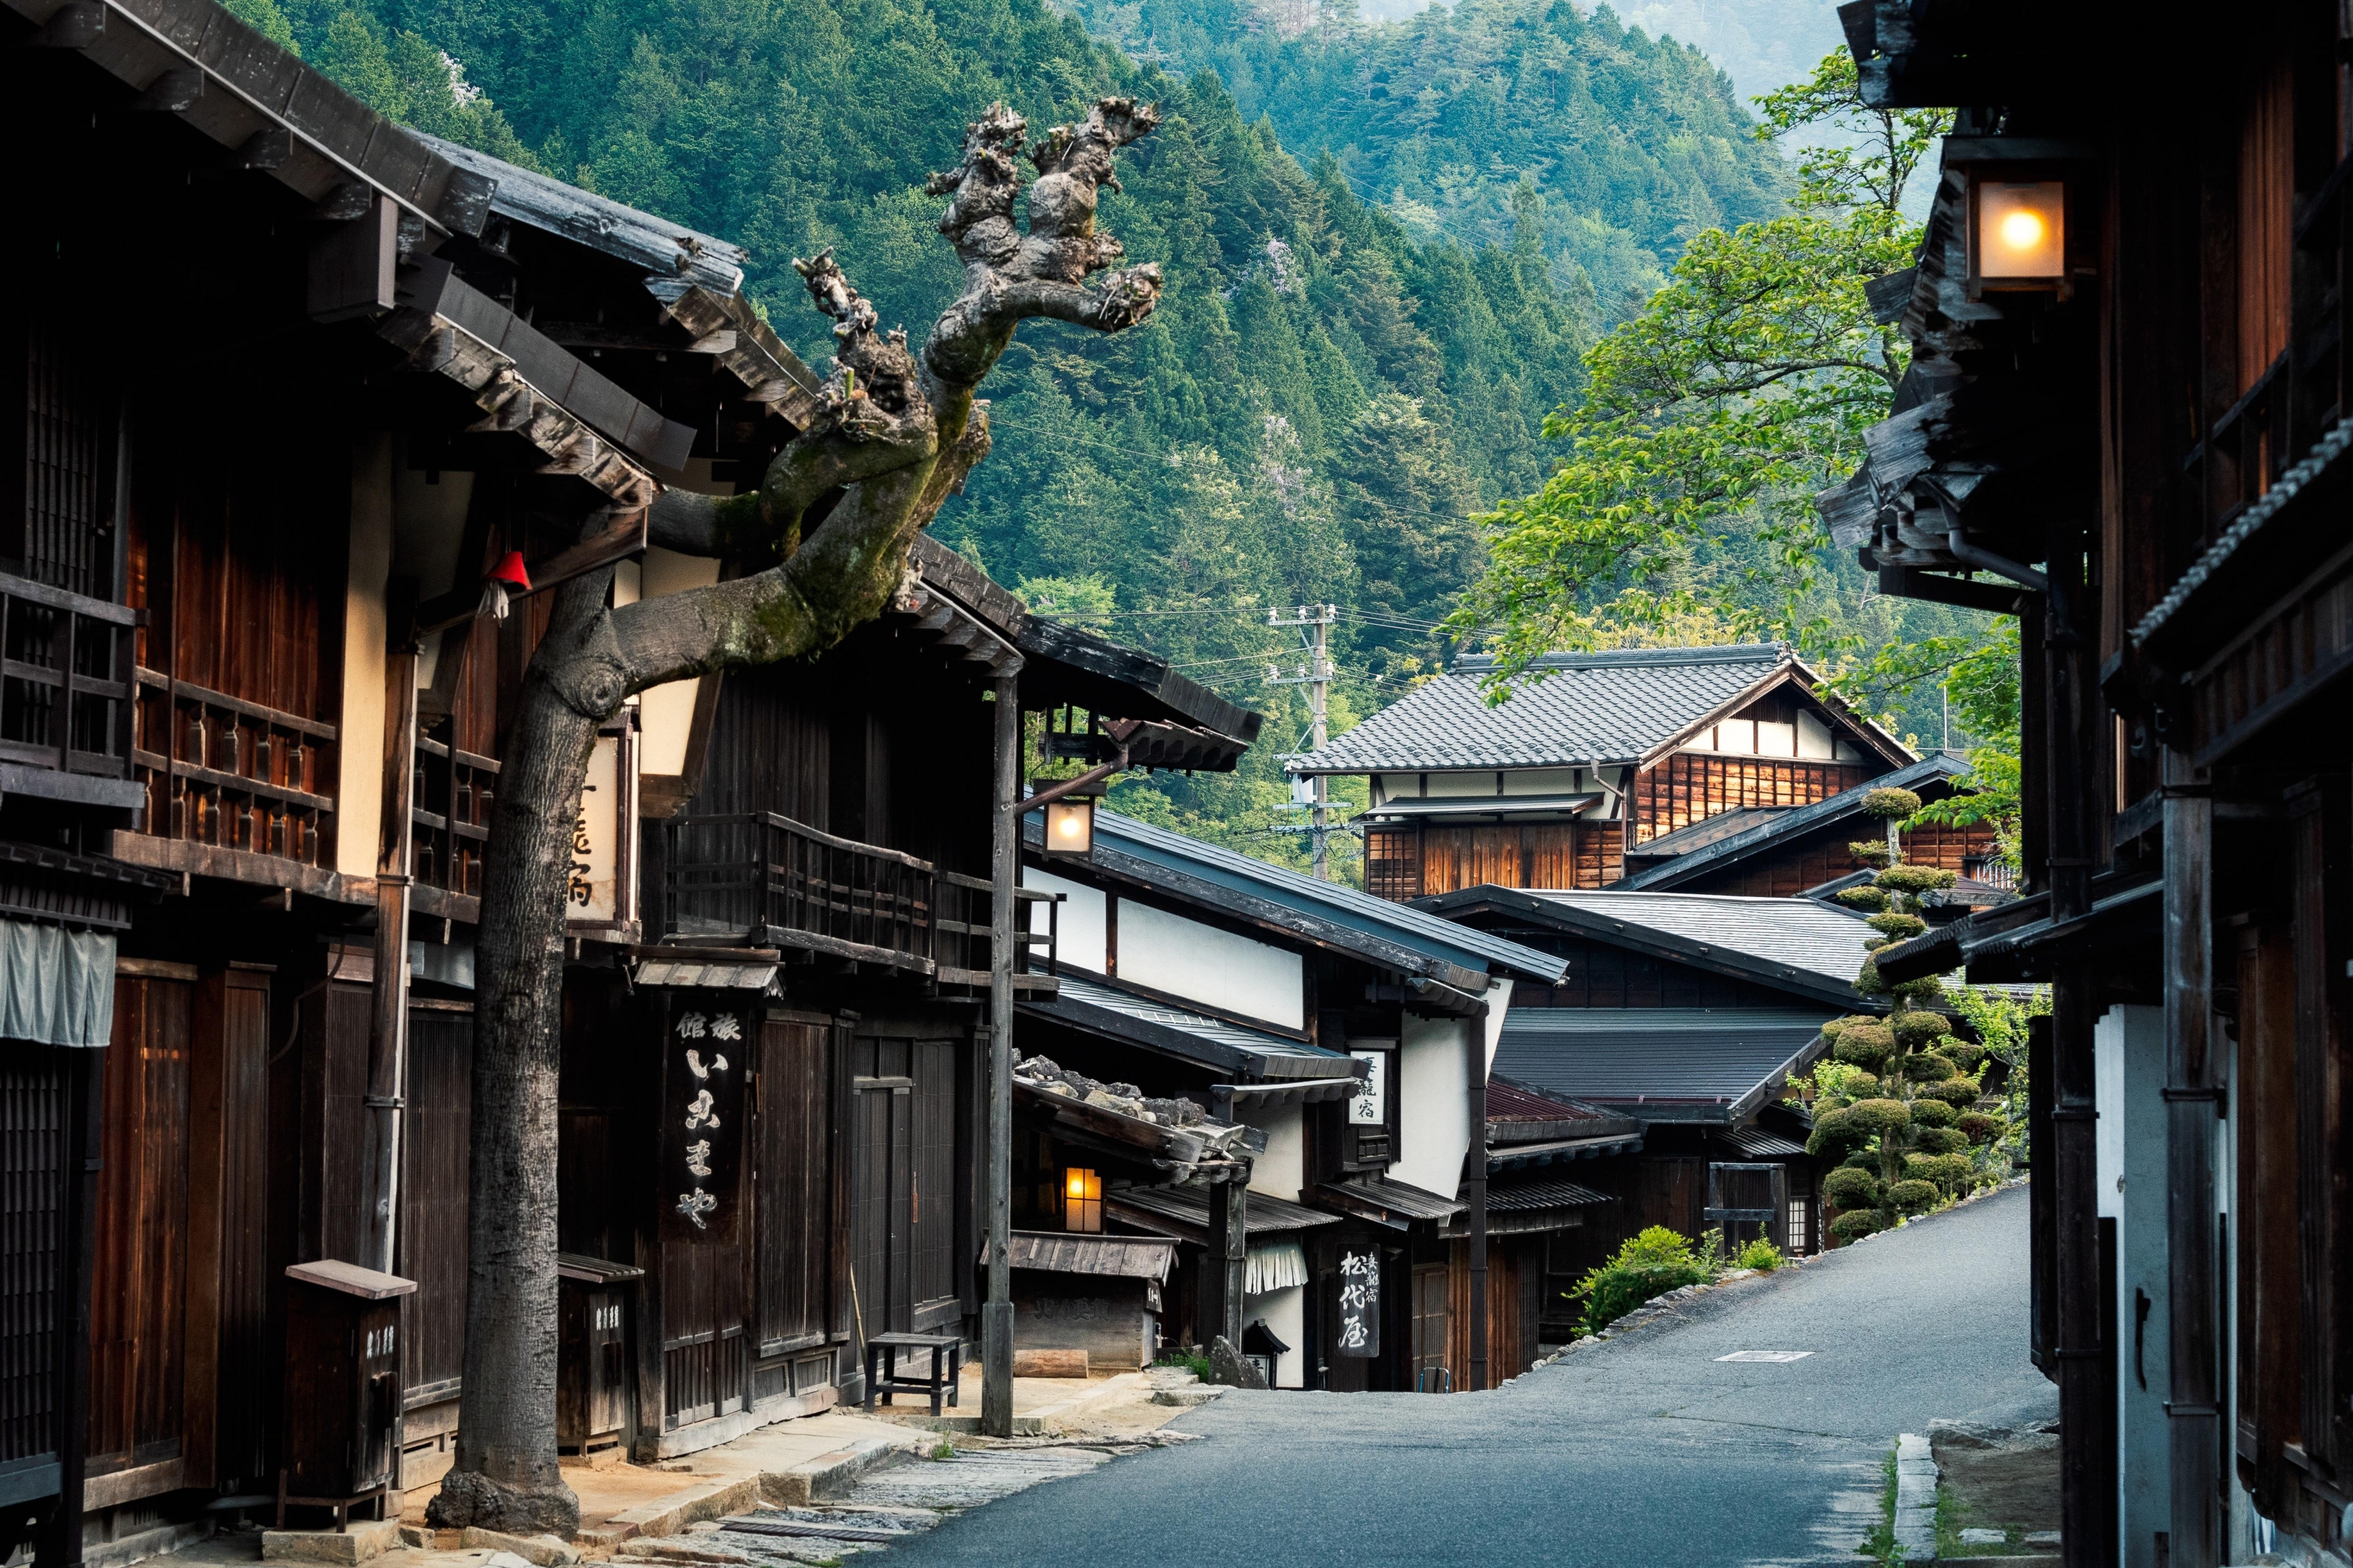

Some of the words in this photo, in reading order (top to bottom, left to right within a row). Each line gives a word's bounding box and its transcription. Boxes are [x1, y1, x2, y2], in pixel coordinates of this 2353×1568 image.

[676, 1010, 742, 1040] 旅館
[1338, 1251, 1368, 1348] 松代屋
[1365, 1251, 1379, 1302] 妻籠宿
